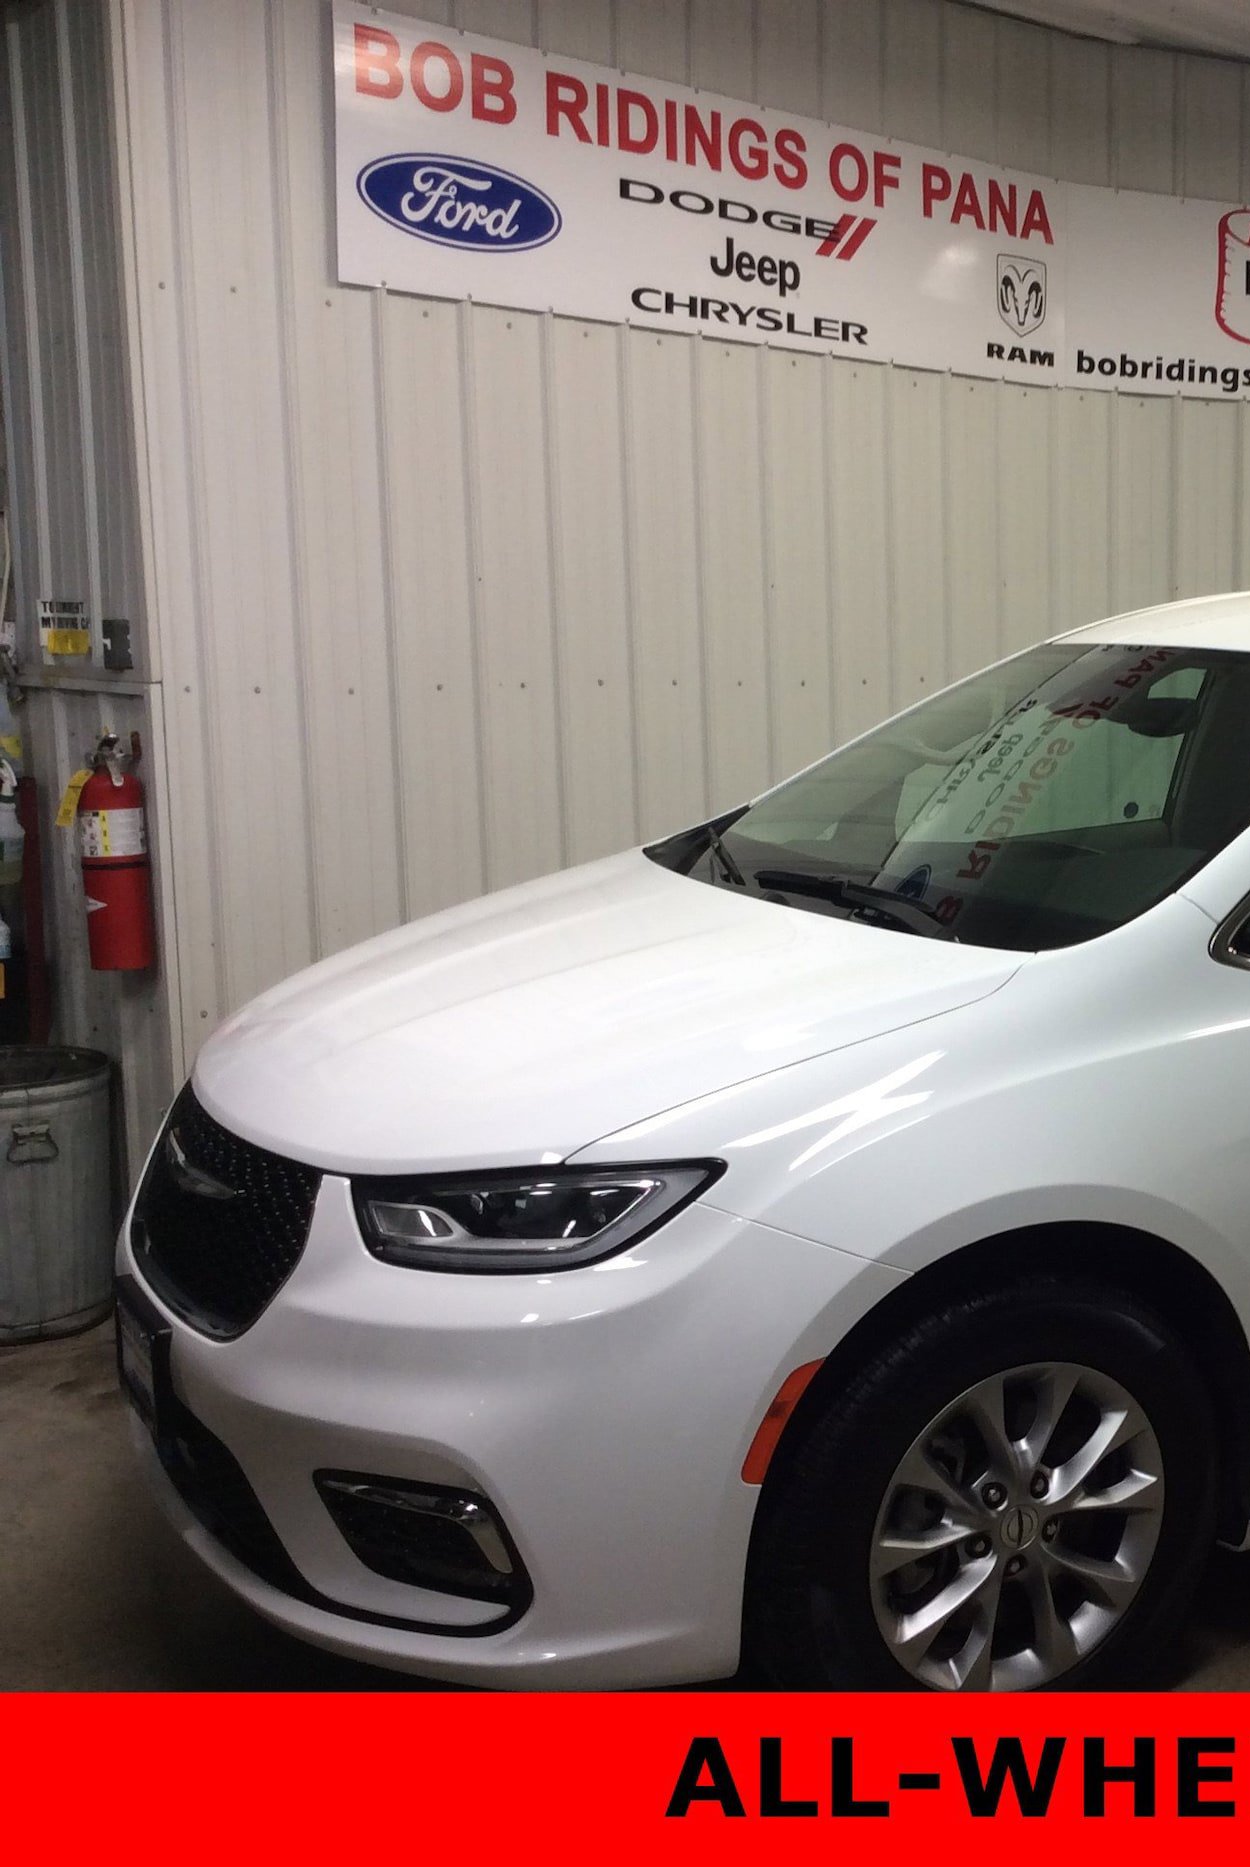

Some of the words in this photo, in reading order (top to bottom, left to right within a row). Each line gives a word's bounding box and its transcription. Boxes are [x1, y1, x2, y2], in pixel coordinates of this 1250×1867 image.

[353, 23, 517, 125] BOB
[545, 72, 807, 191] RIDINGS
[828, 143, 901, 208] OF
[922, 164, 1054, 244] PANA
[401, 166, 521, 239] Ford
[619, 178, 845, 242] DODGE
[710, 237, 801, 296] Jeep
[630, 287, 868, 346] CHRYSLER
[986, 343, 1055, 367] RAM
